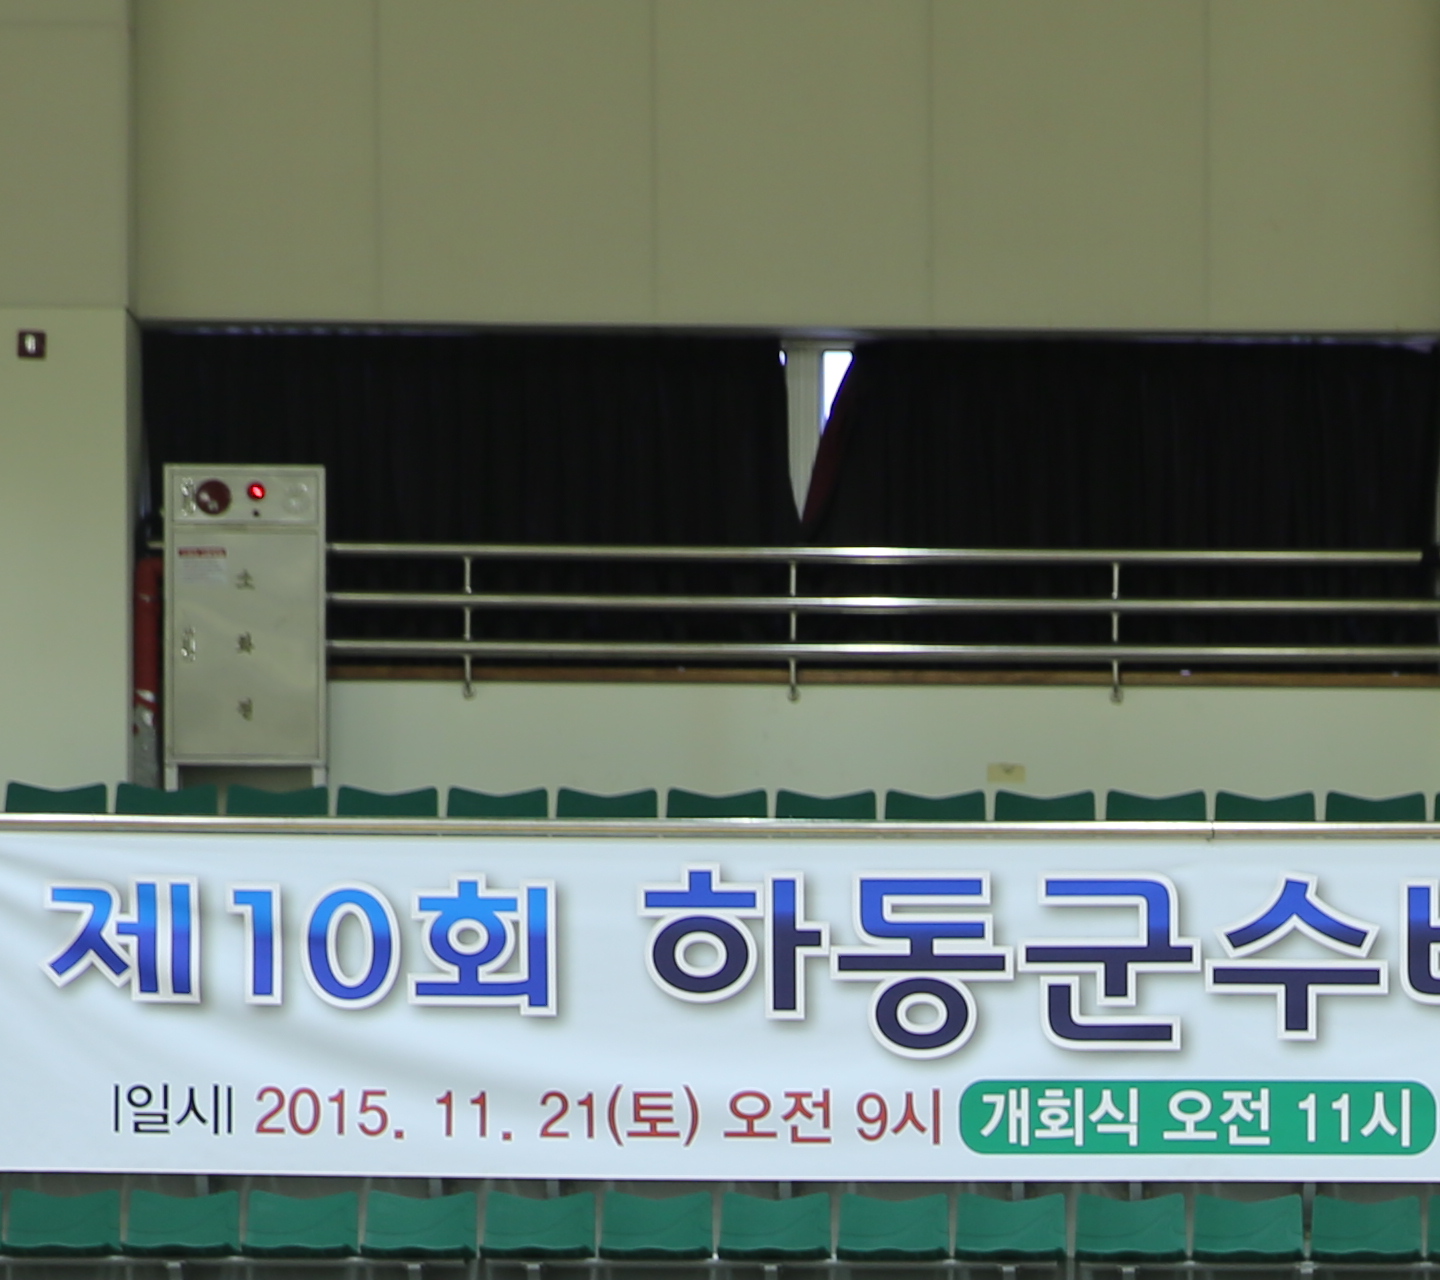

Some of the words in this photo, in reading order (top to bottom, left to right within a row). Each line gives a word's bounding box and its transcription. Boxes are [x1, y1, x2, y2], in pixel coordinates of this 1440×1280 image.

[47, 879, 551, 1011] 제10회
[254, 1086, 406, 1141] 2015.
[435, 1088, 514, 1142] 11.
[538, 1084, 701, 1147] 21(토)
[722, 1088, 832, 1145] 오전
[855, 1087, 943, 1147] 9시
[980, 1085, 1140, 1149] 개회식
[1161, 1087, 1273, 1148] 오전
[1296, 1087, 1414, 1149] 11시
